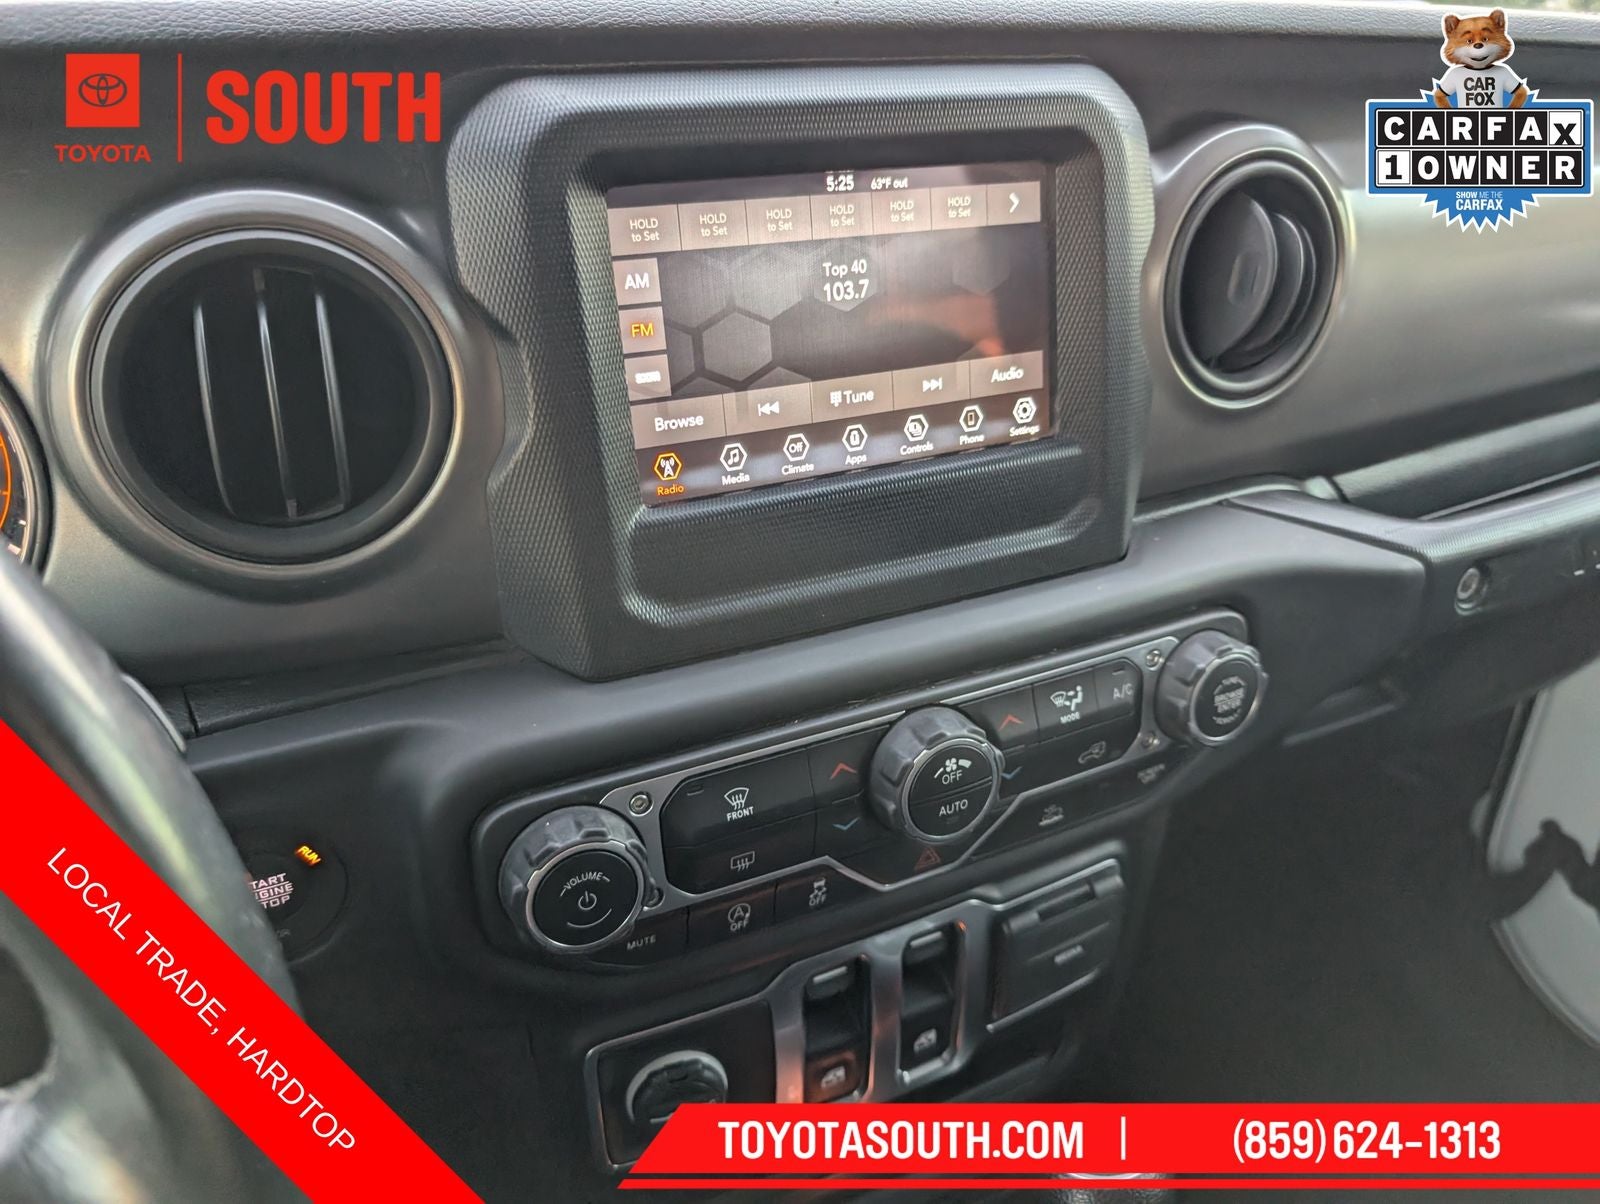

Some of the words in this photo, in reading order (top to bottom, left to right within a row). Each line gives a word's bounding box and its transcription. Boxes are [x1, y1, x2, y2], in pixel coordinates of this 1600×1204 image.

[826, 174, 855, 192] 5:25
[890, 200, 914, 212] HOLD
[947, 196, 971, 207] HOLD
[766, 208, 792, 220] HOLD
[829, 204, 855, 216] HOLD
[891, 213, 900, 222] to
[901, 212, 914, 222] Set
[948, 209, 958, 218] to
[958, 207, 971, 217] Set
[630, 218, 659, 230] HOLD
[699, 213, 727, 225] HOLD
[830, 218, 840, 227] to
[842, 216, 856, 226] Set
[701, 227, 711, 237] to
[713, 225, 728, 236] Set
[767, 222, 777, 232] to
[778, 221, 793, 231] Set
[631, 233, 642, 243] to
[643, 231, 660, 241] Set
[822, 262, 849, 278] Top
[851, 259, 867, 274] 40
[624, 272, 650, 290] AM
[823, 278, 869, 302] 103.7
[631, 323, 654, 338] FM
[991, 366, 1024, 383] Audio
[844, 390, 875, 404] Tune
[654, 415, 704, 432] Browse
[1009, 424, 1040, 438] Settings
[959, 433, 985, 445] Phone
[788, 442, 803, 454] Off
[900, 441, 934, 456] Controls
[845, 454, 867, 466] Apps
[781, 462, 815, 476] Climate
[721, 473, 751, 486] Media
[657, 485, 685, 496] Radio
[1113, 682, 1134, 700] A/C
[1060, 711, 1080, 724] MODE
[941, 769, 963, 785] OFF
[726, 806, 754, 822] FRONT
[939, 799, 969, 817] AUTO
[297, 845, 321, 866] RUN
[249, 872, 287, 890] TART
[565, 871, 604, 891] VOLUME
[255, 882, 295, 900] GINE
[261, 894, 291, 909] TOP
[730, 918, 749, 932] OFF
[626, 934, 657, 950] MUTE
